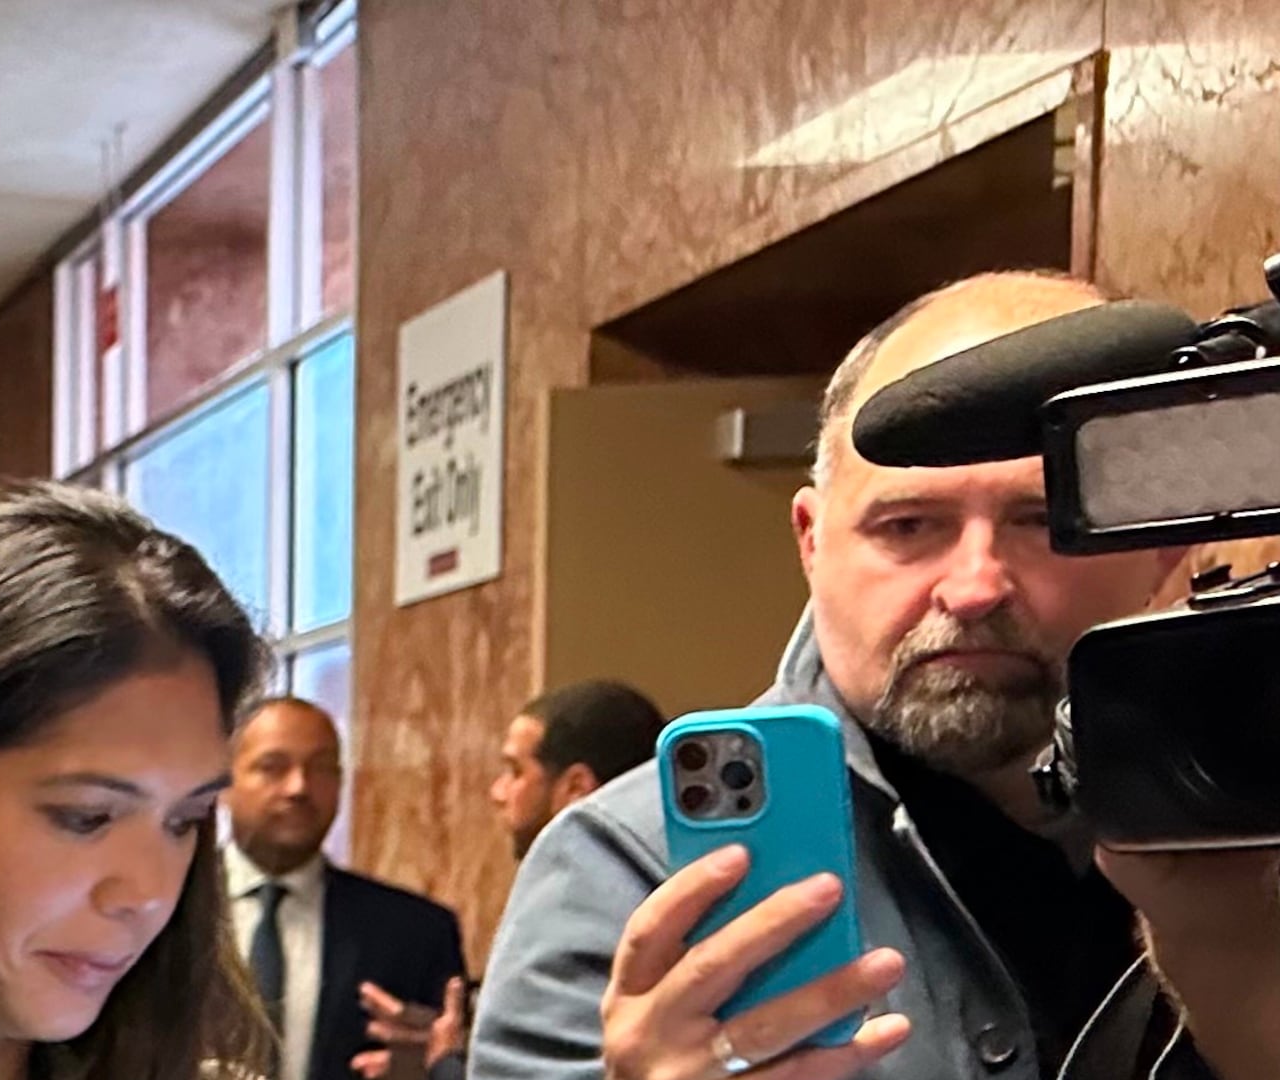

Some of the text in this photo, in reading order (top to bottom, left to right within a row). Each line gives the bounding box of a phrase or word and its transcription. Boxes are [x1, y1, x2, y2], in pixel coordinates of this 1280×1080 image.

[406, 361, 493, 448] Emergency
[411, 452, 483, 537] Exit Only
